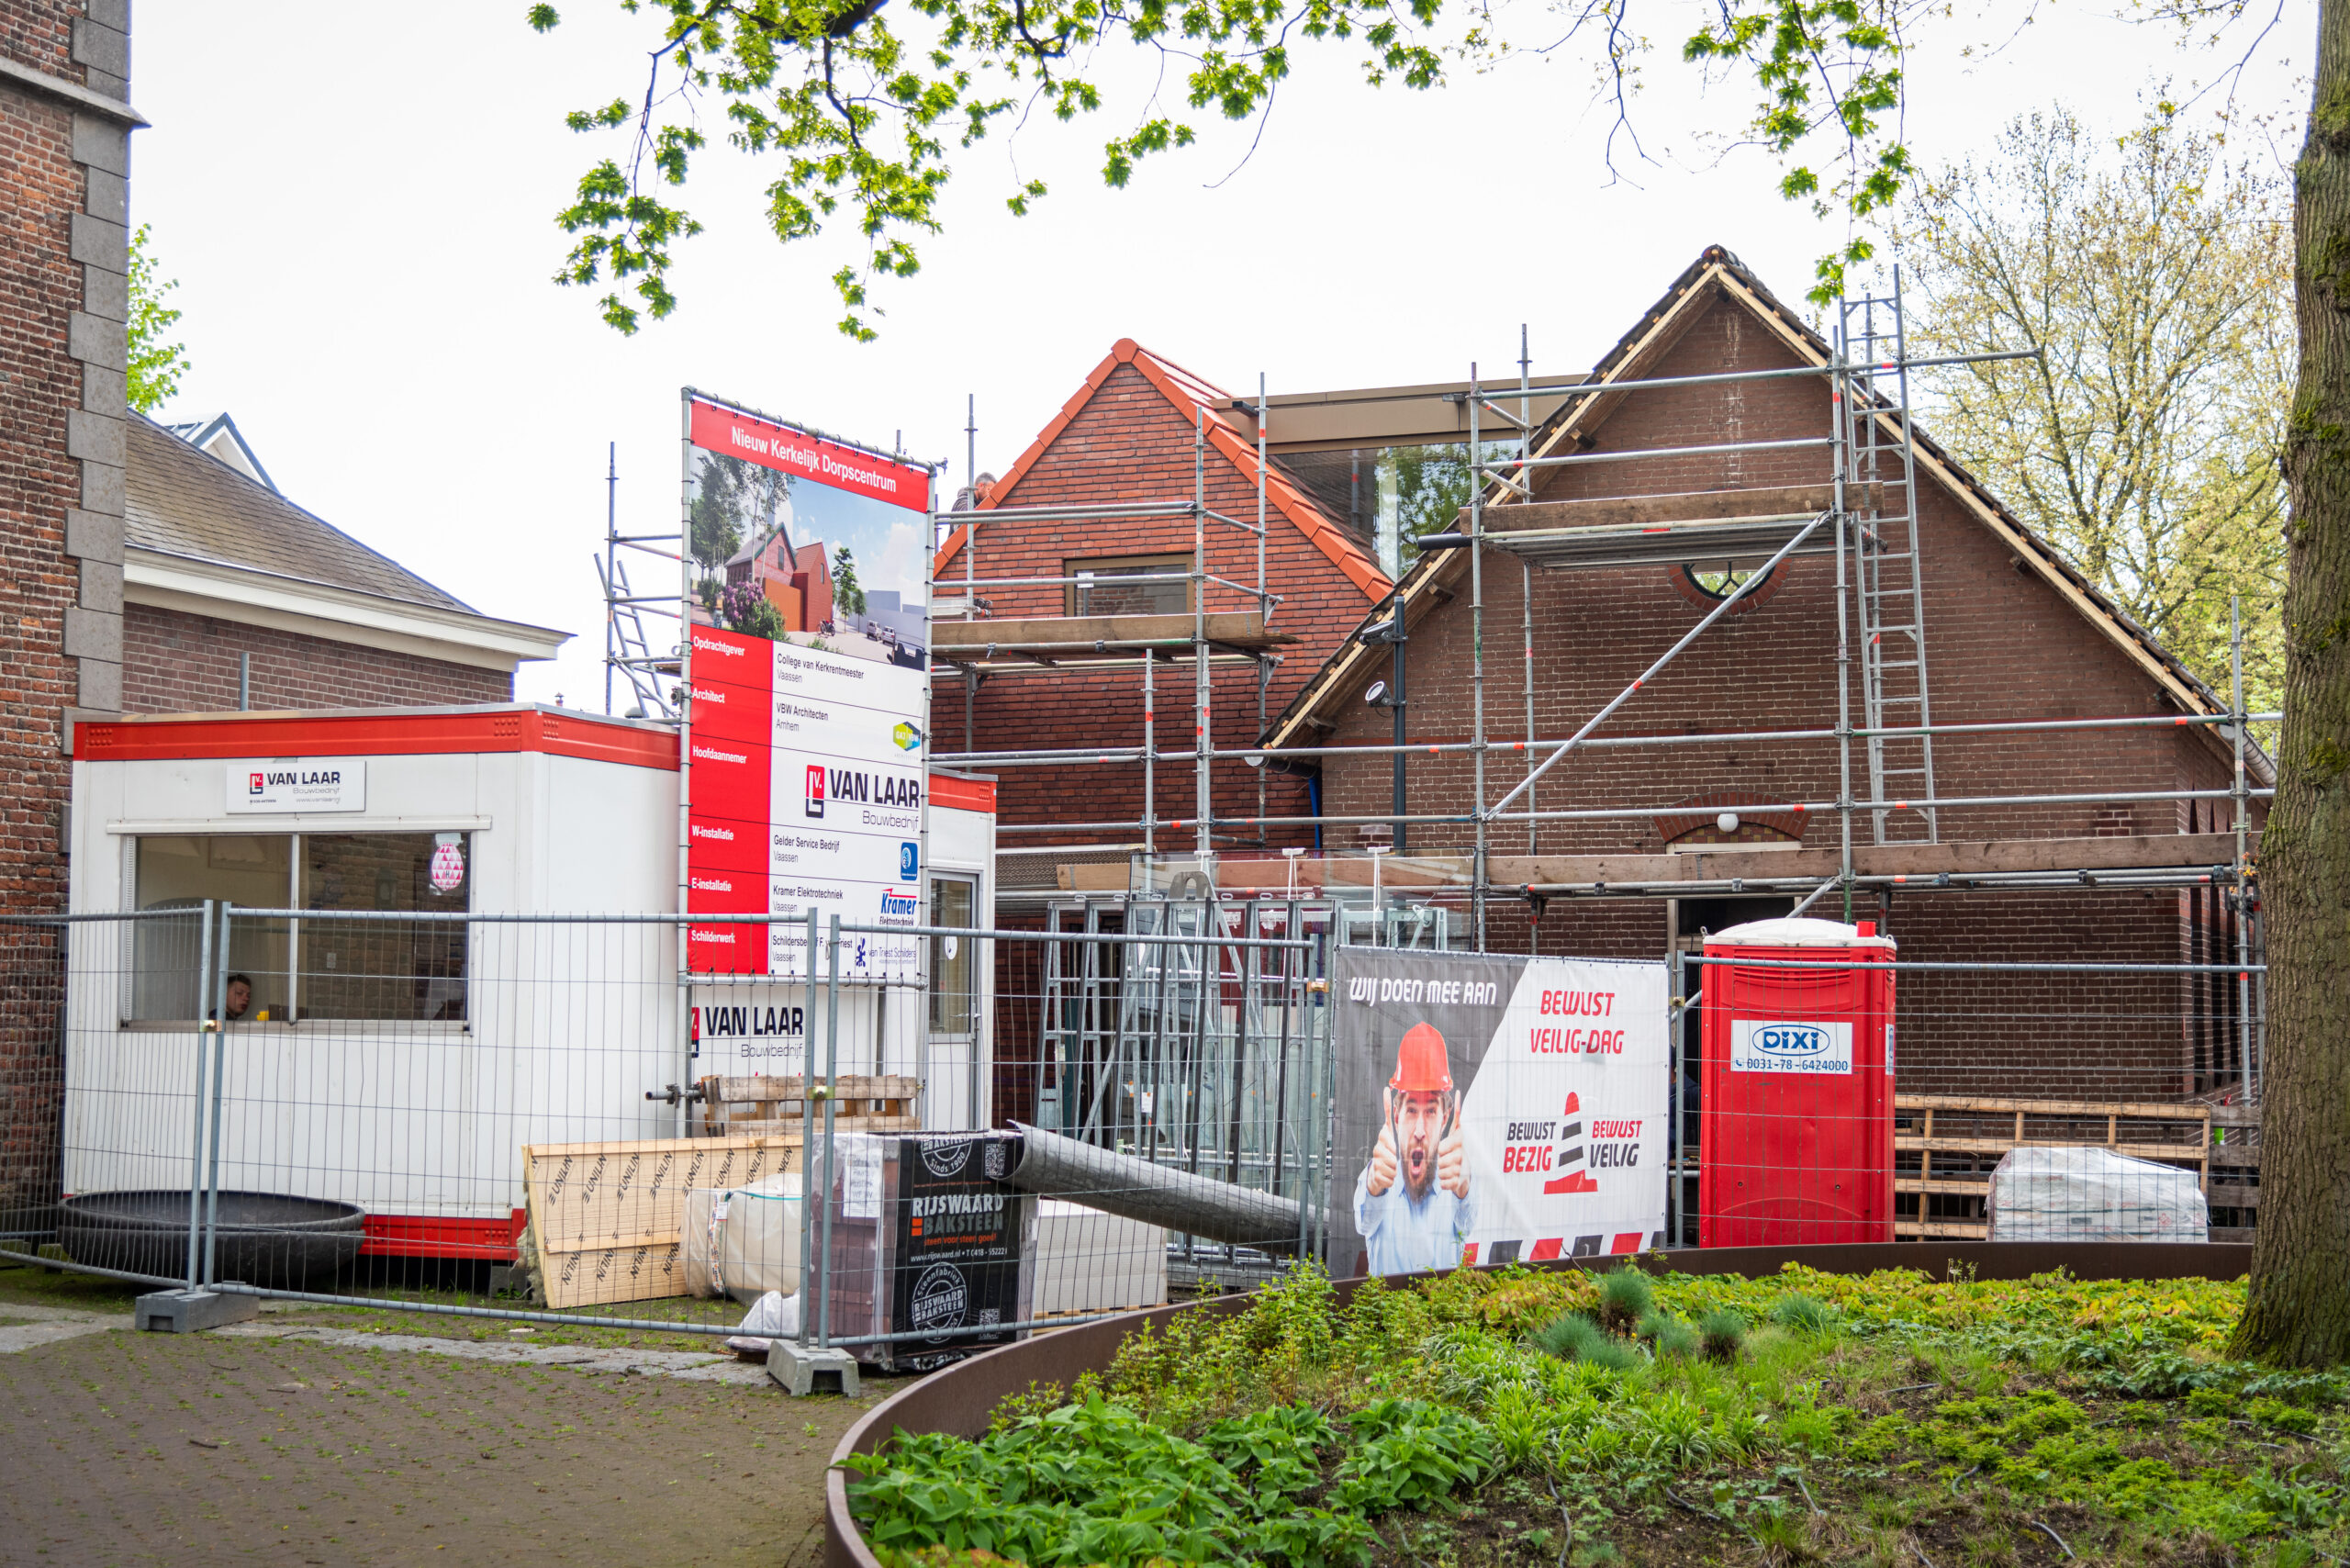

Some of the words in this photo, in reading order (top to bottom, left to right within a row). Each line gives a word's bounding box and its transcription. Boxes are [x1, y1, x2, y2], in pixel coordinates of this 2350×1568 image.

[732, 426, 768, 454] Nieuw
[771, 440, 820, 473] Kerkelijk
[822, 454, 897, 493] Dorpscentrum
[693, 636, 745, 657] Opdrachtgever
[778, 653, 801, 668] College
[802, 661, 814, 670] van
[815, 661, 865, 679] Kerkrentmeester
[777, 669, 803, 684] Vaassen
[692, 688, 725, 704] Architect
[777, 702, 793, 716] VBW
[793, 705, 829, 722] Architecten
[776, 719, 800, 733] Arnhem
[693, 745, 747, 765] Hoofdaannemer
[267, 772, 297, 785] VAN
[302, 771, 341, 785] LAAR
[293, 787, 340, 795] Bouwbedrijf
[830, 768, 868, 802] VAN
[874, 774, 920, 809] LAAR
[862, 811, 919, 832] Bouwbedrijf
[692, 824, 733, 841] W-installatie
[774, 834, 795, 847] Gelder
[796, 836, 819, 849] Service
[820, 839, 840, 853] Bedrijf
[774, 850, 799, 864] Vaassen
[691, 877, 732, 892] E-installatie
[773, 885, 796, 898] Kramer
[797, 887, 844, 901] Elektrotechniek
[773, 901, 798, 913] Vaassen
[881, 893, 917, 915] Kramer
[691, 930, 735, 944] Schilderwerk
[772, 951, 797, 963] Vaassen
[1349, 977, 1377, 1006] WIJ
[1381, 979, 1423, 1002] DOEN
[1427, 980, 1459, 1004] MEE
[1463, 982, 1496, 1005] AAN
[1540, 990, 1615, 1016] BEWUST
[705, 1006, 747, 1036] VAN
[754, 1007, 803, 1036] LAAR
[741, 1044, 803, 1058] Bouwbedrijf
[1530, 1028, 1625, 1055] VEILIG-DAG
[1507, 1121, 1556, 1141] BEWUST
[1592, 1120, 1642, 1138] BEWUST
[930, 1159, 948, 1172] Sinds
[951, 1151, 965, 1170] 1900
[1503, 1146, 1552, 1173] BEZIG
[1589, 1143, 1639, 1168] VEILIG
[912, 1193, 1004, 1217] RIJSWAARD
[923, 1213, 1003, 1236] BAKSTEEN
[923, 1237, 942, 1246] steen
[959, 1235, 977, 1243] steen
[979, 1233, 997, 1244] goed!
[914, 1290, 963, 1313] RIJSWAARD
[922, 1299, 964, 1320] BAKSTEEN
